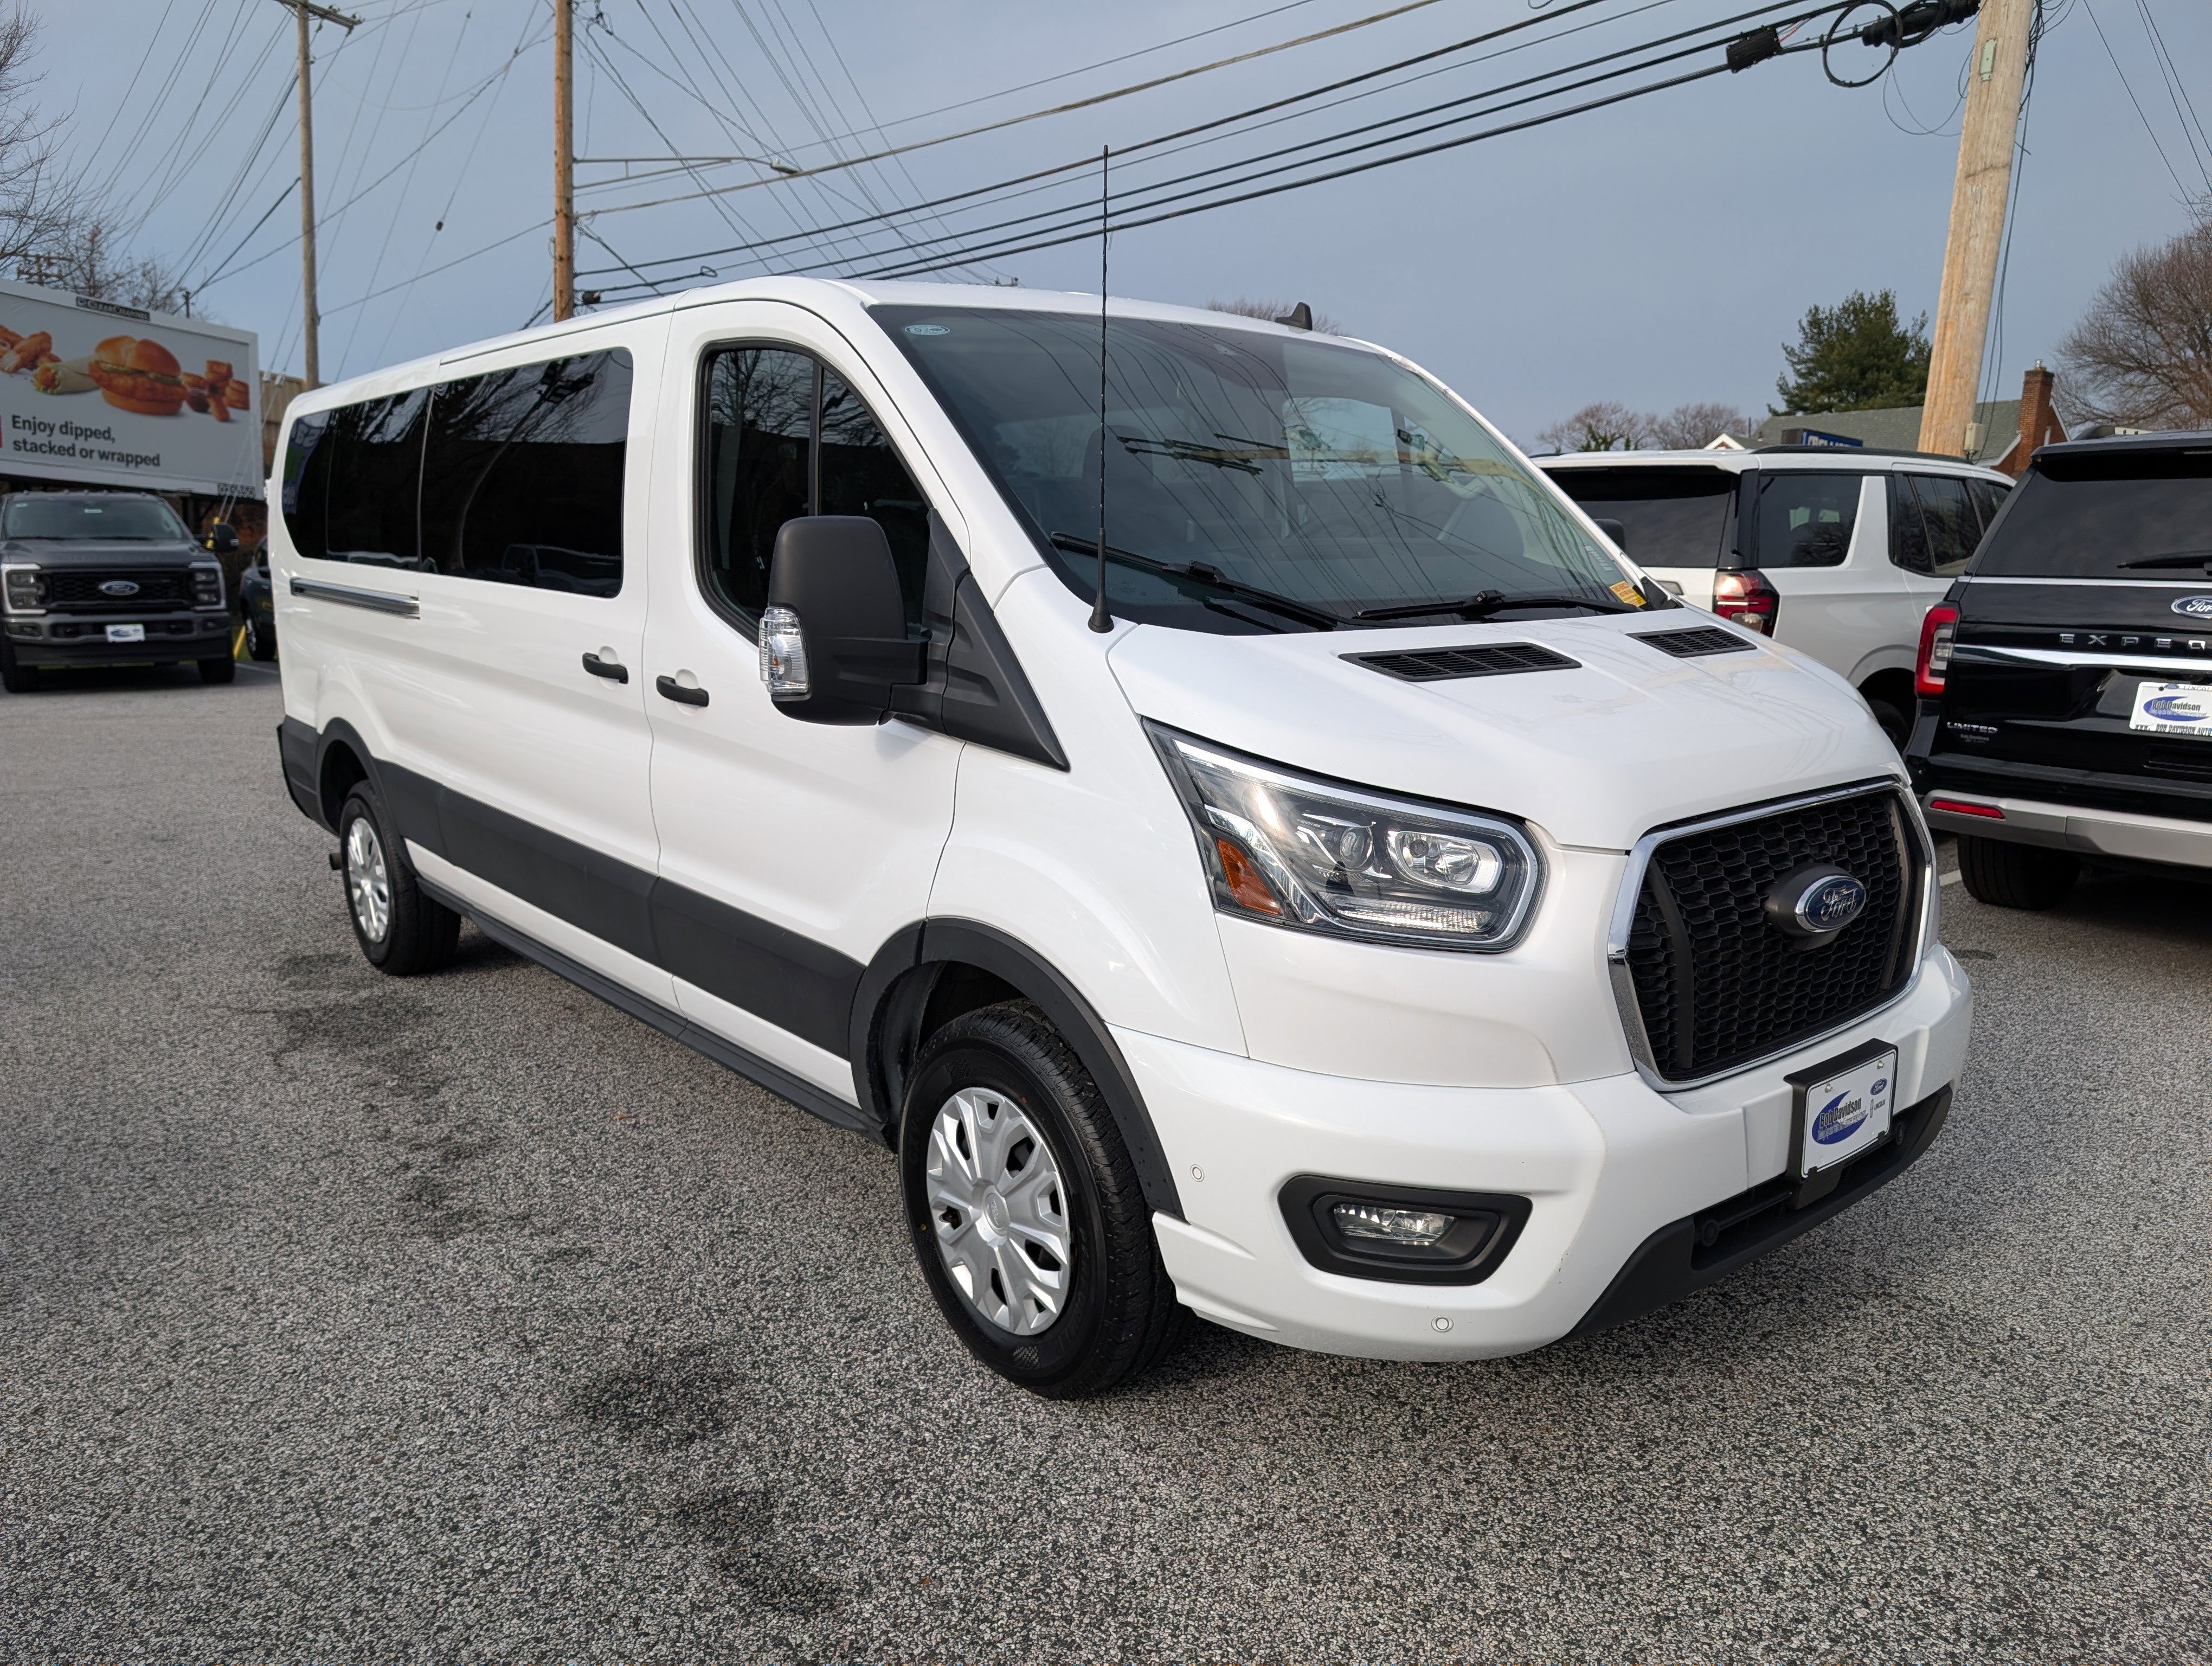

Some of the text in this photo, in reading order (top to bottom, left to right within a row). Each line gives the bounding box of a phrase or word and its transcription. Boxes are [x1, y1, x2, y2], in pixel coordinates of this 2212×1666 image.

[11, 414, 115, 443] Enjoy dipped,
[13, 438, 160, 468] stacked or wrapped
[2152, 700, 2201, 711] Bob Davidson
[1946, 721, 1998, 734] LIMITED
[1821, 885, 1859, 921] Ford
[1820, 1110, 1834, 1127] Bob
[1834, 1098, 1862, 1122] Davidson
